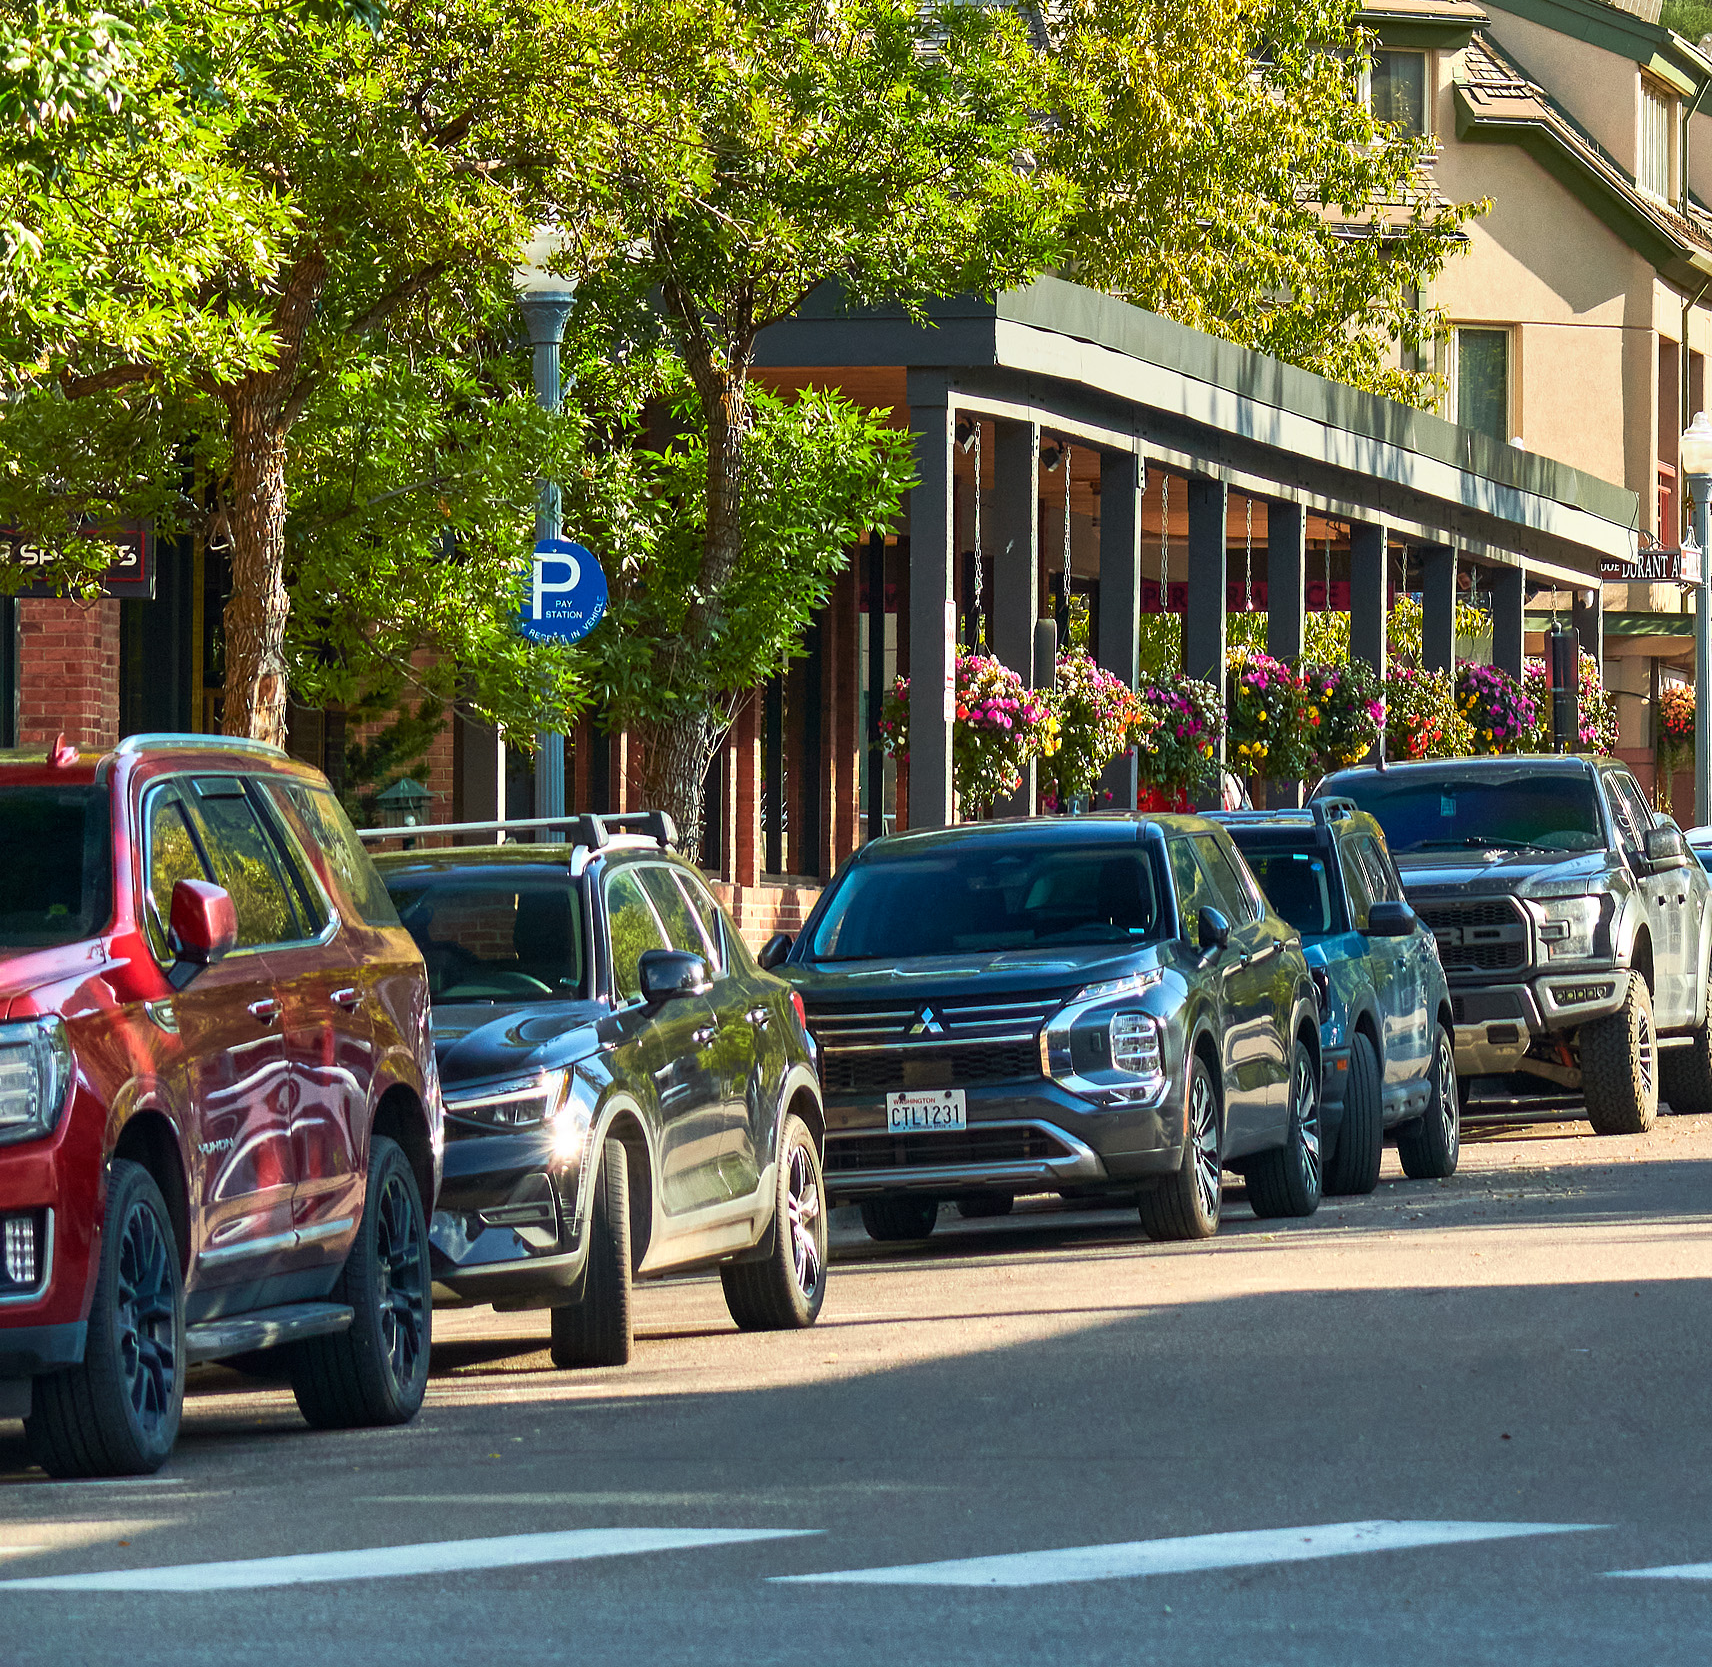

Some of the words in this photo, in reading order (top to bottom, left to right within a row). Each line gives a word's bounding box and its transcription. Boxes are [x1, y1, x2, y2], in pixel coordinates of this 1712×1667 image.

[1622, 555, 1669, 578] DURANT
[533, 553, 580, 620] P
[556, 600, 572, 608] PAY
[570, 630, 580, 639] IN
[582, 595, 604, 630] VEHICLE
[892, 1104, 958, 1126] CTL1231
[198, 1137, 233, 1155] YUKON
